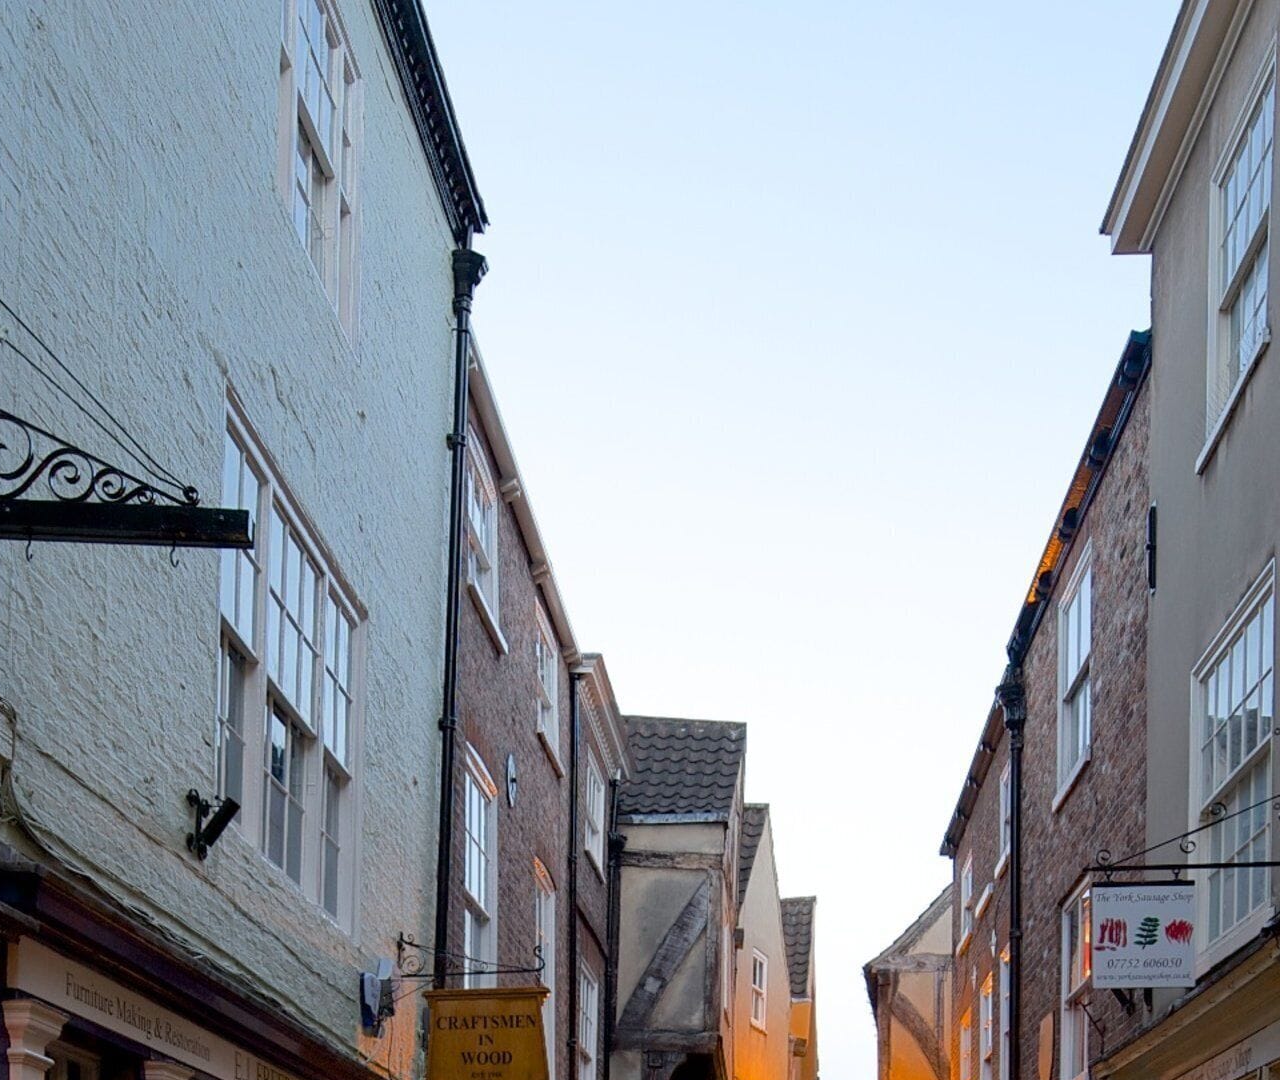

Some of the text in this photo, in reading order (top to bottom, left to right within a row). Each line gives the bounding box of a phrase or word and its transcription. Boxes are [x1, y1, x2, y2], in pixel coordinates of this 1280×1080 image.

[1095, 891, 1194, 904] The York Sausage Shop
[66, 972, 210, 1062] Furniture Making & Restoration
[436, 1014, 536, 1030] CRAFTSMEN
[478, 1033, 494, 1046] IN
[461, 1050, 513, 1066] WOOD
